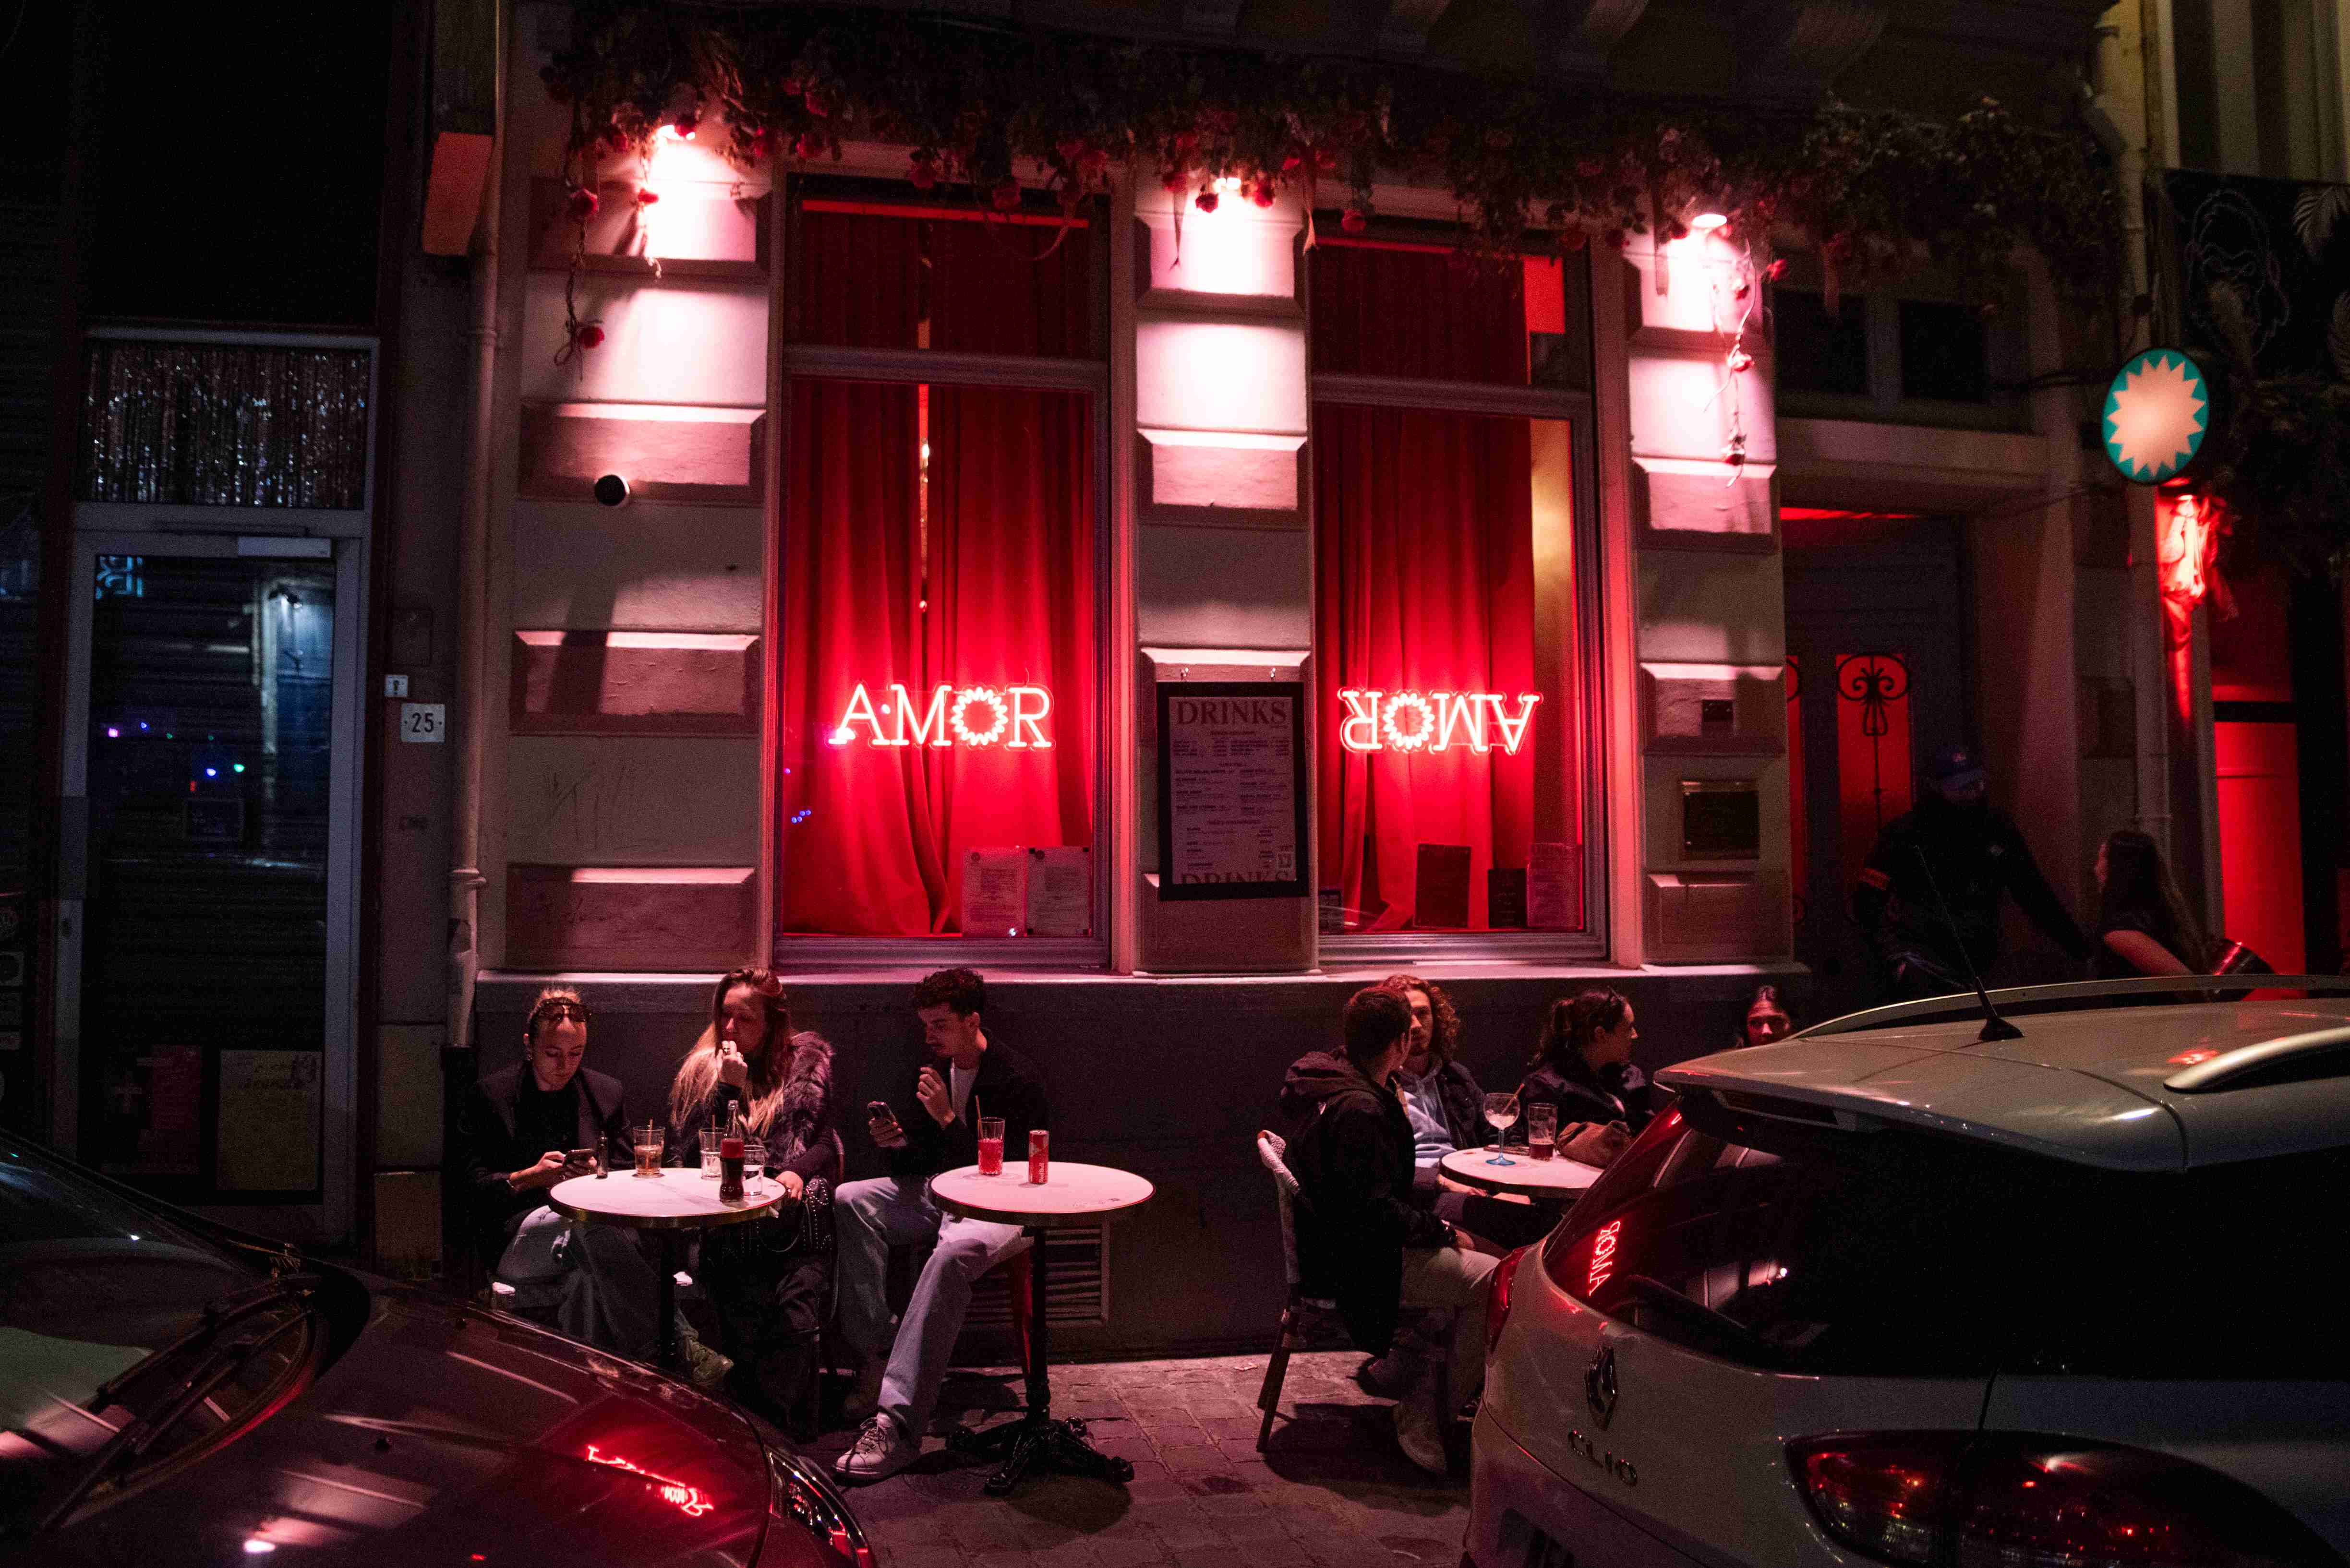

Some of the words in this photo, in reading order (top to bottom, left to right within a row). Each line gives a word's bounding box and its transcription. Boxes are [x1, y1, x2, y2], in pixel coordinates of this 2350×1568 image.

[412, 713, 434, 733] 25
[828, 683, 1052, 748] AMOR
[1177, 701, 1287, 725] DRINKS
[1567, 1429, 1638, 1487] CLIO
